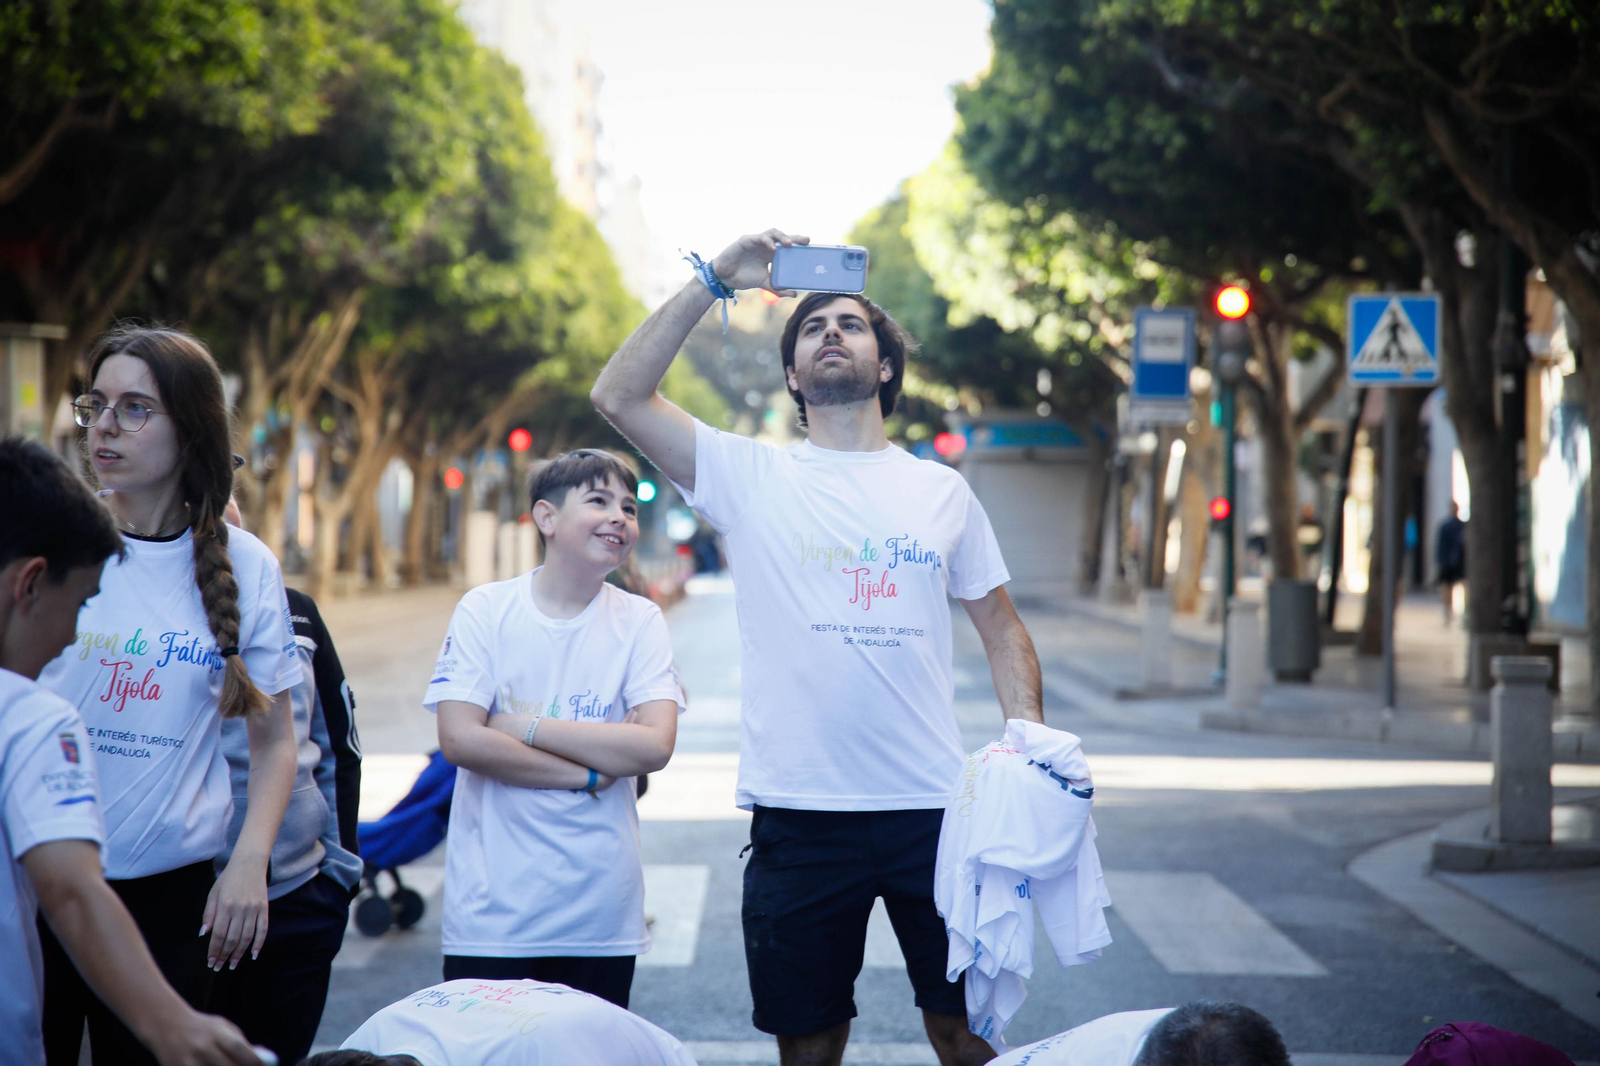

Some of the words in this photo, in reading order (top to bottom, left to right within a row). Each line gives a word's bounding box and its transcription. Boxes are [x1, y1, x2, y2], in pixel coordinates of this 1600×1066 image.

[792, 532, 854, 572] Virgen
[859, 537, 881, 562] de
[885, 533, 942, 571] Fátima
[125, 627, 151, 656] de
[811, 624, 838, 632] FIESTA
[840, 624, 850, 633] DE
[853, 625, 886, 635] INTERÉS
[889, 626, 924, 637] TURÍSTICO
[844, 636, 854, 645] DE
[856, 637, 901, 648] ANDALUCÍA
[546, 694, 562, 719] de
[97, 727, 137, 743] INTERÉS
[140, 734, 184, 749] TURÍSTICO
[97, 744, 151, 760] ANDALUCÍA
